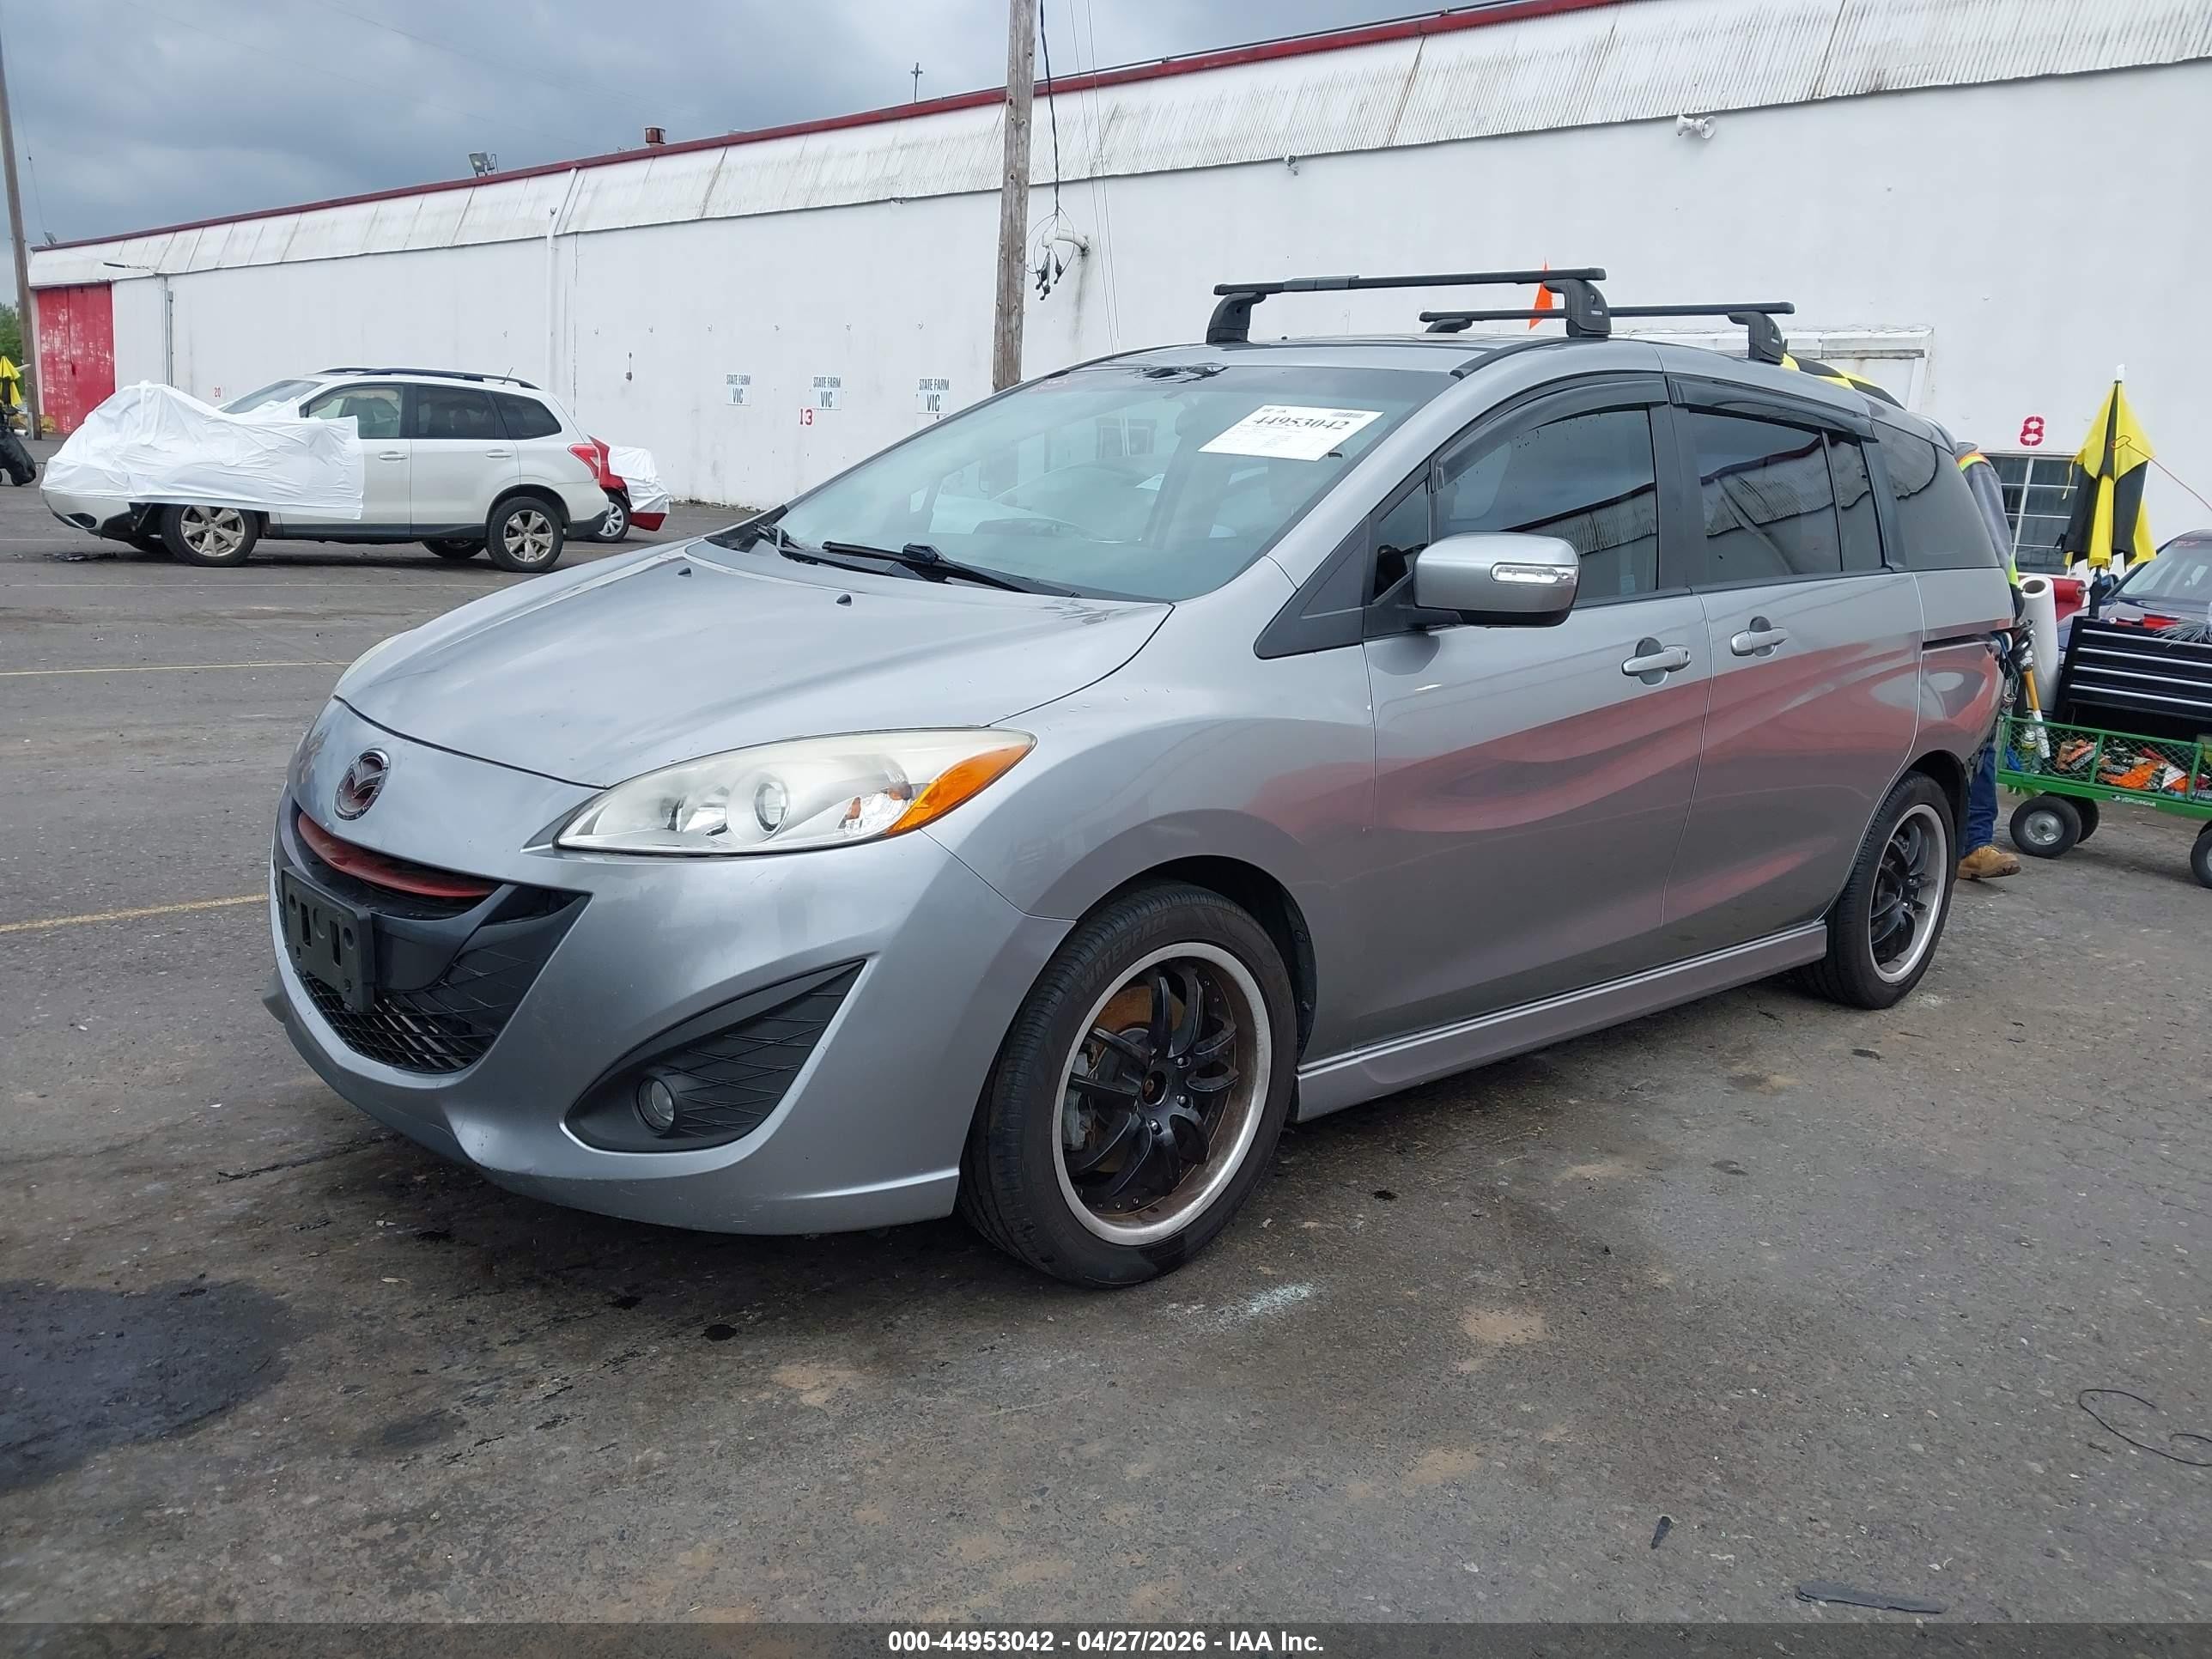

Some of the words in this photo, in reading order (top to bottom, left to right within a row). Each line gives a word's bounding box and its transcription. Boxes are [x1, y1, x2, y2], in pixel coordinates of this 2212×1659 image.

[726, 374, 738, 386] STATE
[738, 374, 751, 386] FARM
[812, 376, 827, 388] STATE
[827, 376, 842, 389] FARM
[918, 378, 933, 392] STATE
[933, 378, 950, 392] FARM
[732, 387, 744, 404] VIC
[820, 391, 833, 408] VIC
[927, 393, 940, 412] VIC
[799, 408, 813, 426] 13
[1252, 416, 1351, 430] 44953042
[2020, 415, 2045, 447] 8
